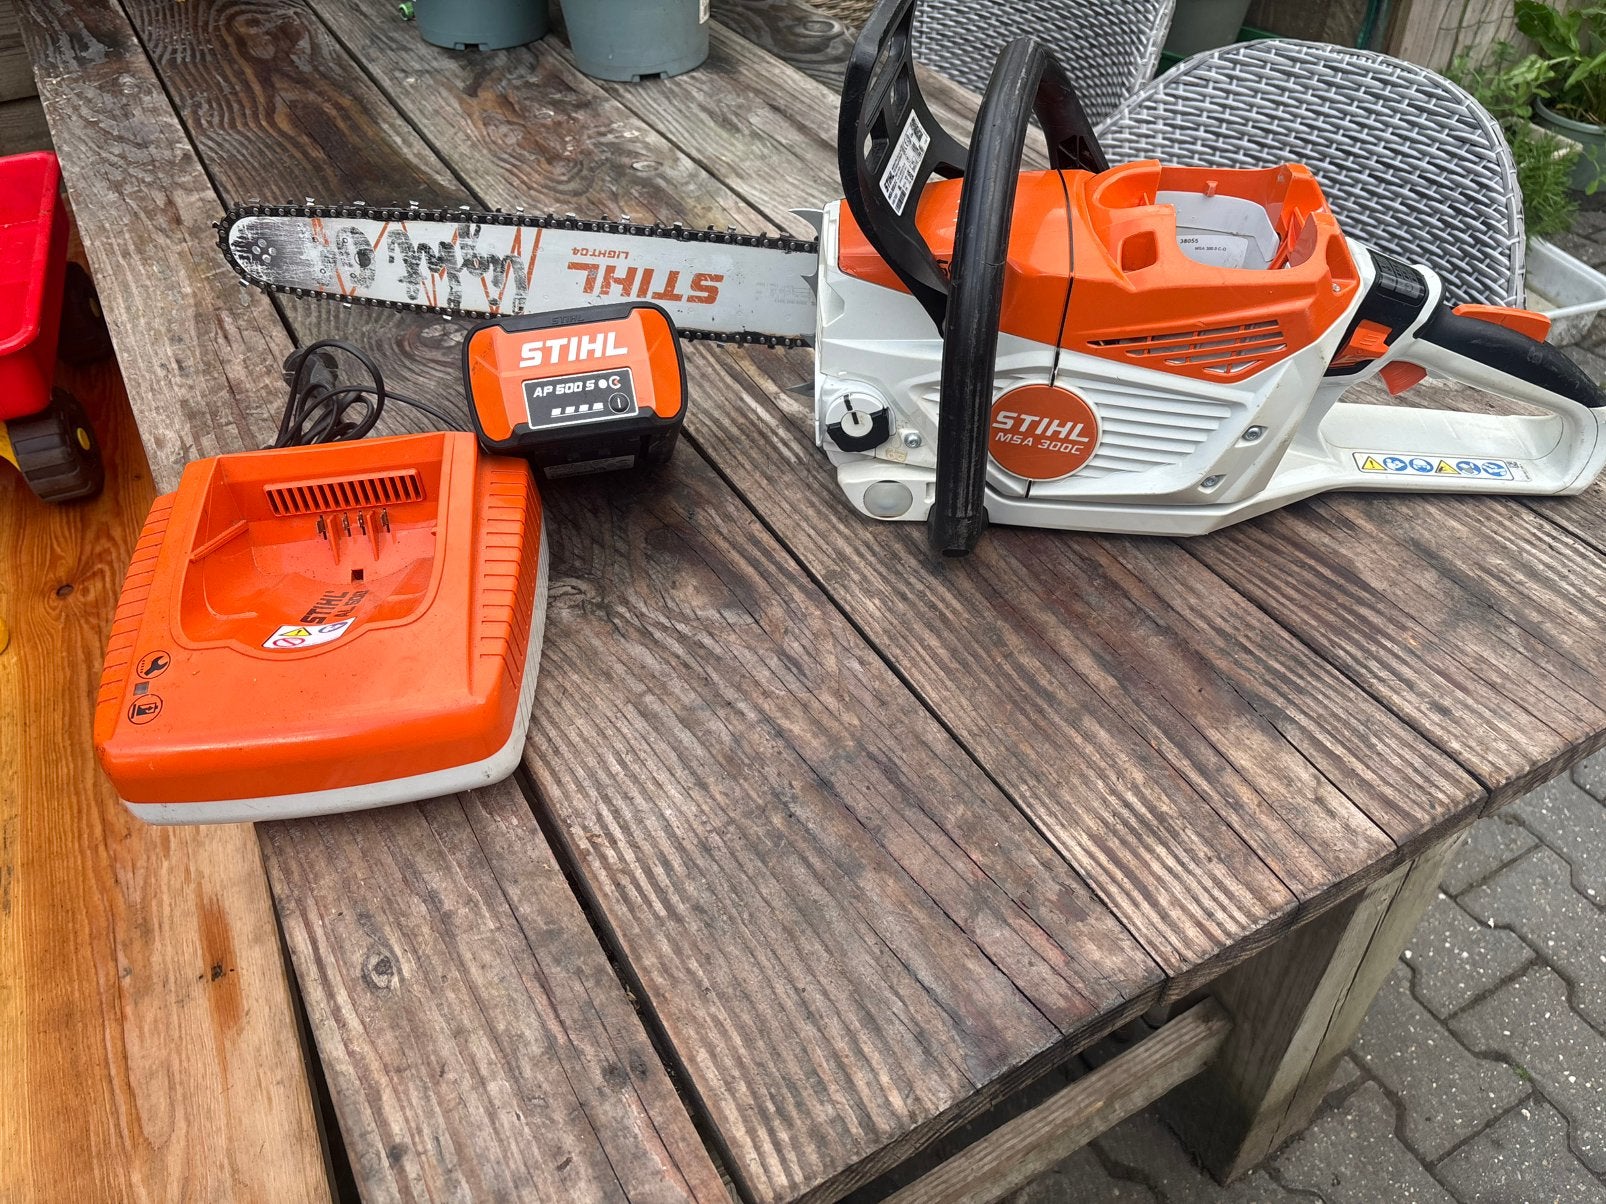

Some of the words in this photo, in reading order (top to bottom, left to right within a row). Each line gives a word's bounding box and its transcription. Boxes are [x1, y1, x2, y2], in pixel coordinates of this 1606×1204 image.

[567, 262, 724, 304] STIHL
[519, 331, 628, 368] STIHL
[533, 385, 554, 398] AP
[585, 379, 596, 391] S
[992, 410, 1090, 443] STIHL
[995, 432, 1033, 447] MSA
[300, 591, 349, 625] STIHL
